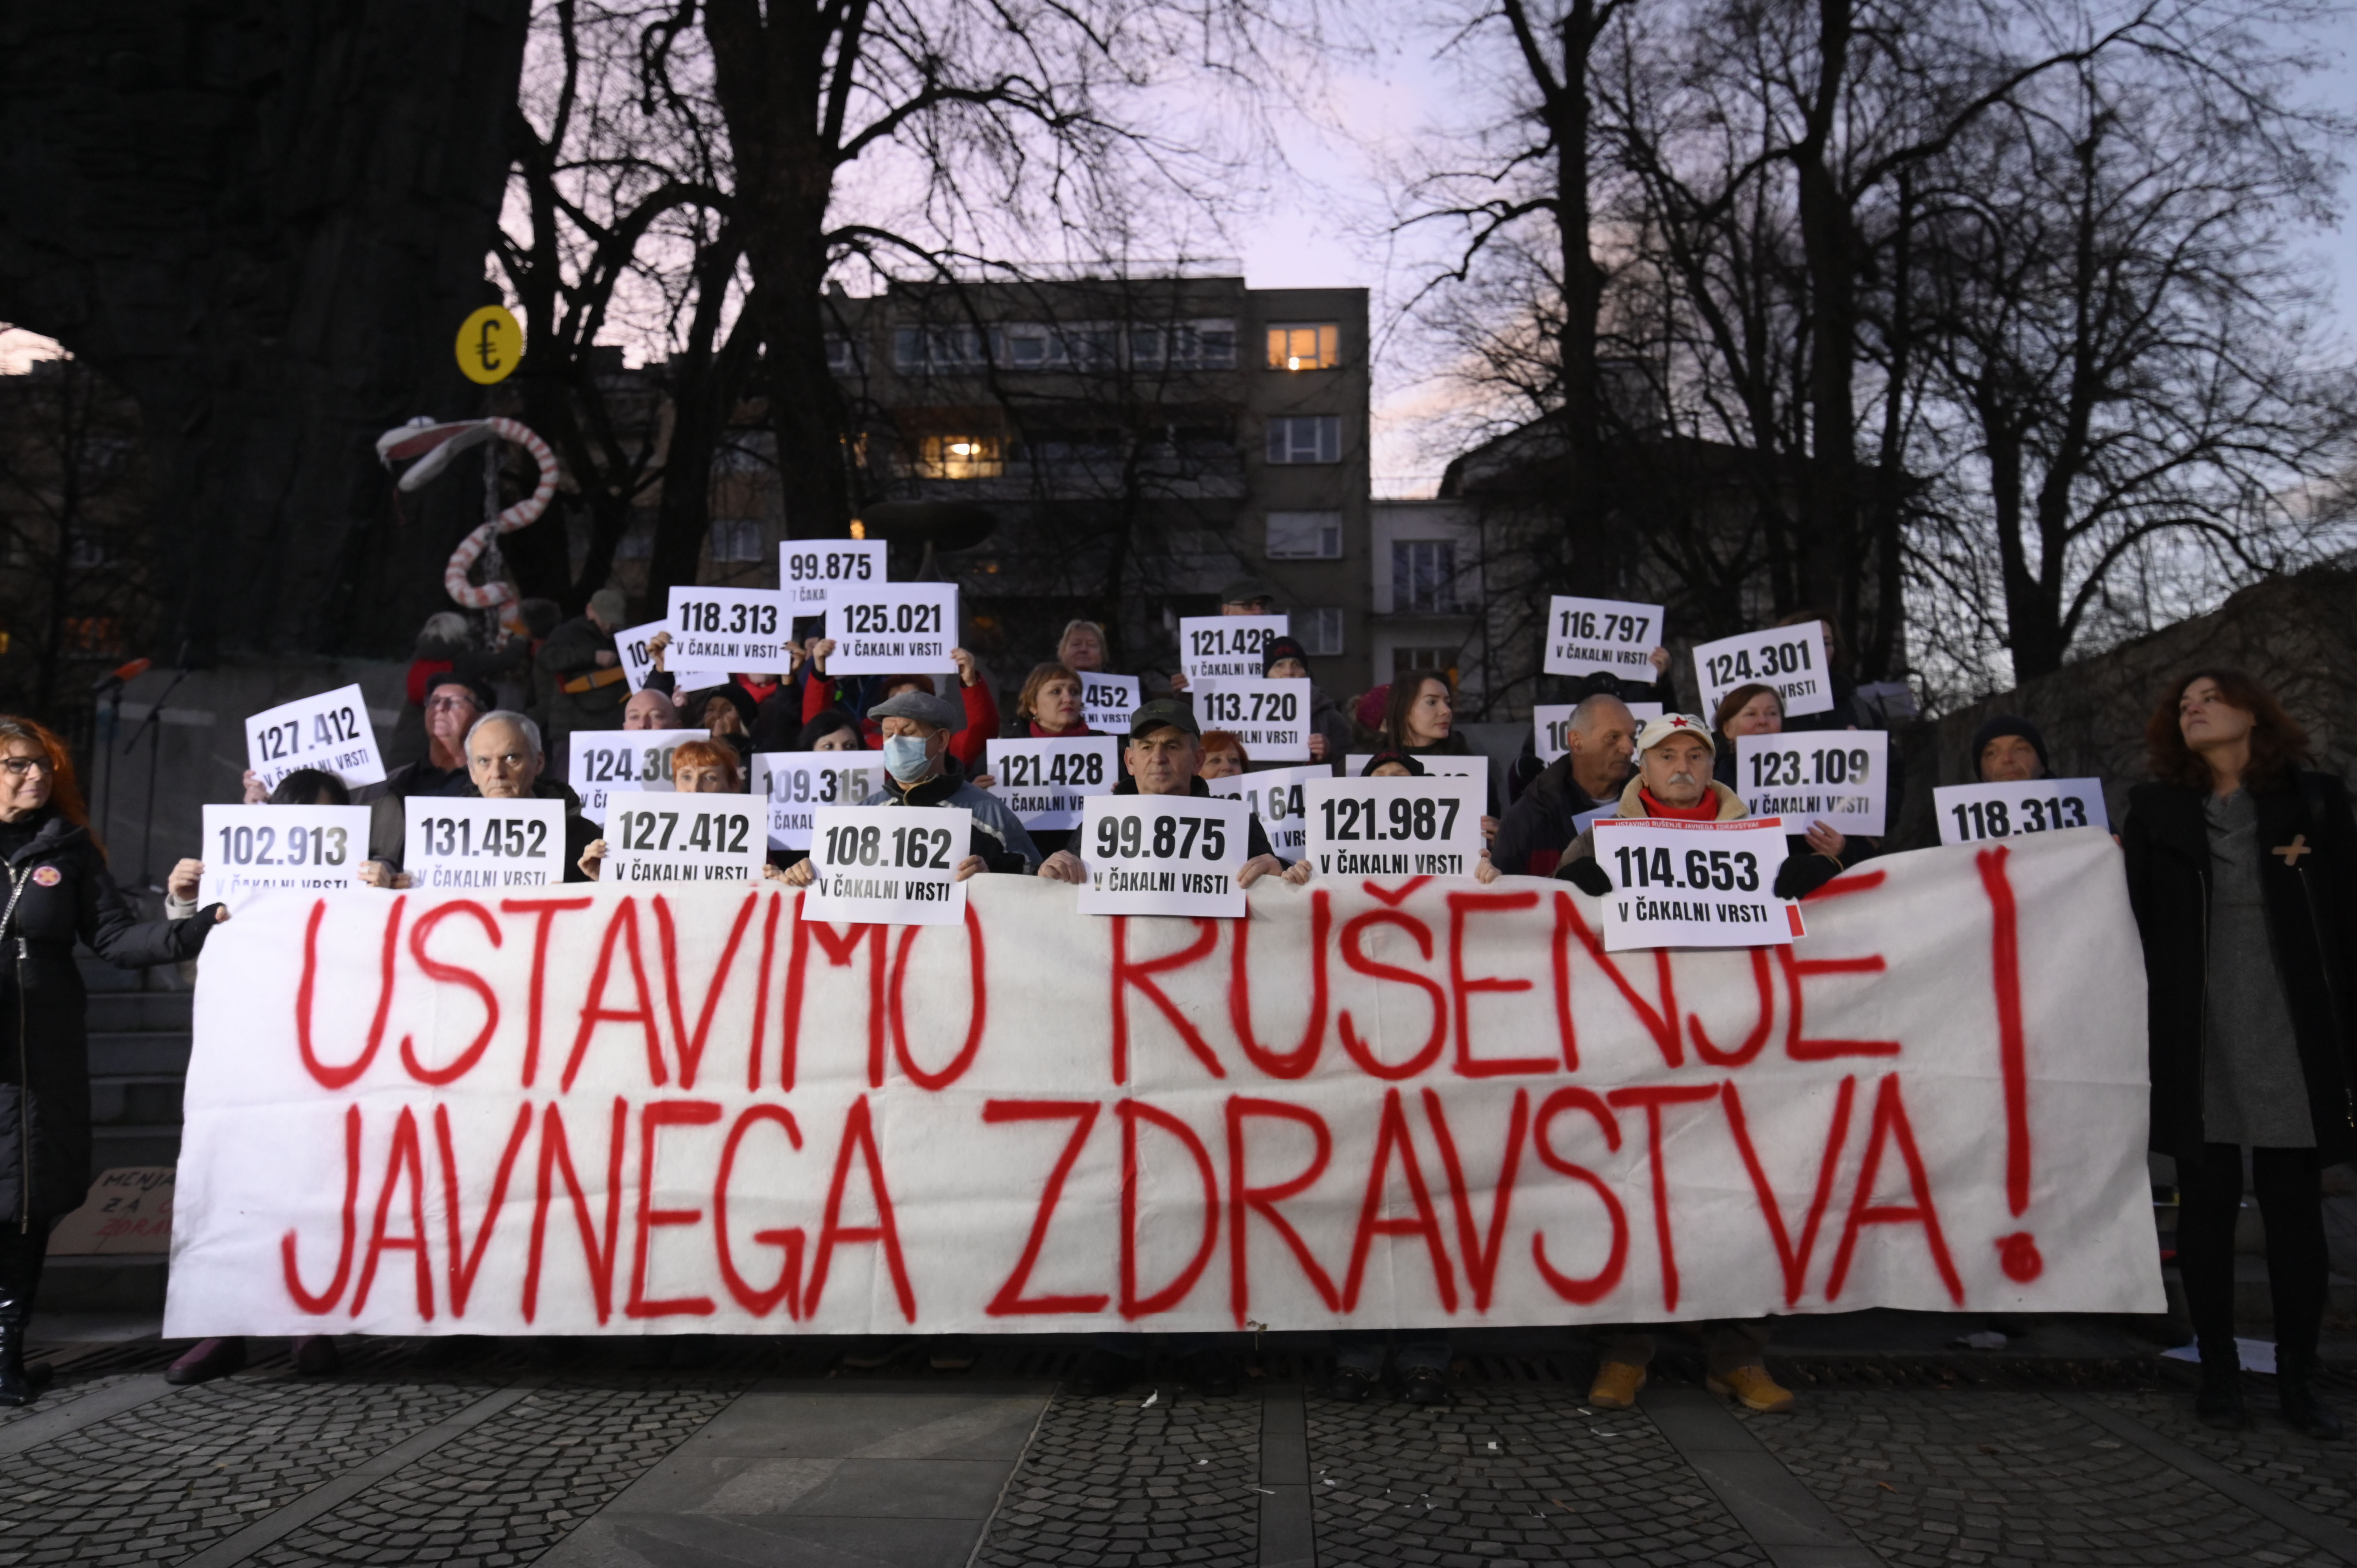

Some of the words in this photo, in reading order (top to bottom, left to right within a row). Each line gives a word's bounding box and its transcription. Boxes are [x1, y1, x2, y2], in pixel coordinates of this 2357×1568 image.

[790, 553, 871, 581] 99.875
[680, 601, 777, 635] 118.313
[844, 604, 941, 634] 125.021
[1559, 610, 1650, 643] 116.797
[677, 642, 684, 655] V
[689, 639, 739, 657] ČAKALNI
[744, 644, 777, 659] VRSTI
[843, 643, 849, 657] V
[855, 638, 905, 657] ČAKALNI
[909, 642, 942, 656] VRSTI
[1556, 645, 1563, 658] V
[1567, 643, 1613, 662] ČAKALNI
[1617, 650, 1648, 666] VRSTI
[1706, 639, 1811, 687] 124.301
[1191, 664, 1197, 676] V
[1201, 660, 1244, 676] ČAKALNI
[1248, 662, 1263, 675] VR
[1779, 679, 1816, 699] VRSTI
[1203, 693, 1297, 721] 113.720
[257, 707, 360, 761] 127.412
[1266, 731, 1298, 744] VRSTI
[263, 773, 274, 788] V
[335, 748, 369, 770] VRSTI
[583, 748, 675, 782] 124.30
[999, 753, 1103, 787] 121.428
[1750, 749, 1869, 787] 123.109
[581, 793, 587, 808] V
[763, 768, 869, 803] 109.315
[1012, 793, 1065, 812] ČAKALNI
[1749, 798, 1757, 814] V
[1763, 794, 1821, 814] ČAKALNI
[1827, 796, 1869, 815] VRSTI
[620, 811, 749, 853] 127.412
[1320, 798, 1460, 841] 121.987
[1652, 820, 1682, 829] RUŠENJE
[1684, 822, 1714, 830] JAVNEGA
[1952, 796, 2087, 842] 118.313
[219, 826, 348, 866] 102.913
[421, 818, 547, 858] 131.452
[826, 826, 952, 869] 108.162
[1097, 815, 1225, 861] 99.875
[418, 869, 428, 886] V
[433, 863, 497, 887] ČAKALNI
[503, 871, 546, 886] VRSTI
[616, 862, 625, 880] V
[631, 858, 698, 881] ČAKALNI
[705, 865, 748, 880] VRSTI
[1320, 855, 1330, 874] V
[1338, 849, 1408, 874] ČAKALNI
[1415, 854, 1463, 874] VRSTI
[1615, 846, 1760, 892] 114.653
[820, 878, 827, 896] V
[834, 874, 898, 899] ČAKALNI
[905, 881, 950, 902] VRSTI
[1093, 872, 1103, 892] V
[1109, 867, 1175, 893] ČAKALNI
[1182, 872, 1228, 895] VRSTI
[1618, 902, 1628, 923] V
[1636, 895, 1710, 922] ČAKALNI
[1717, 903, 1768, 923] VRSTI
[296, 890, 986, 1093] USTAVIMO
[1110, 871, 1900, 1086] RUŠENJE
[281, 1094, 917, 1327] JAVNEGA
